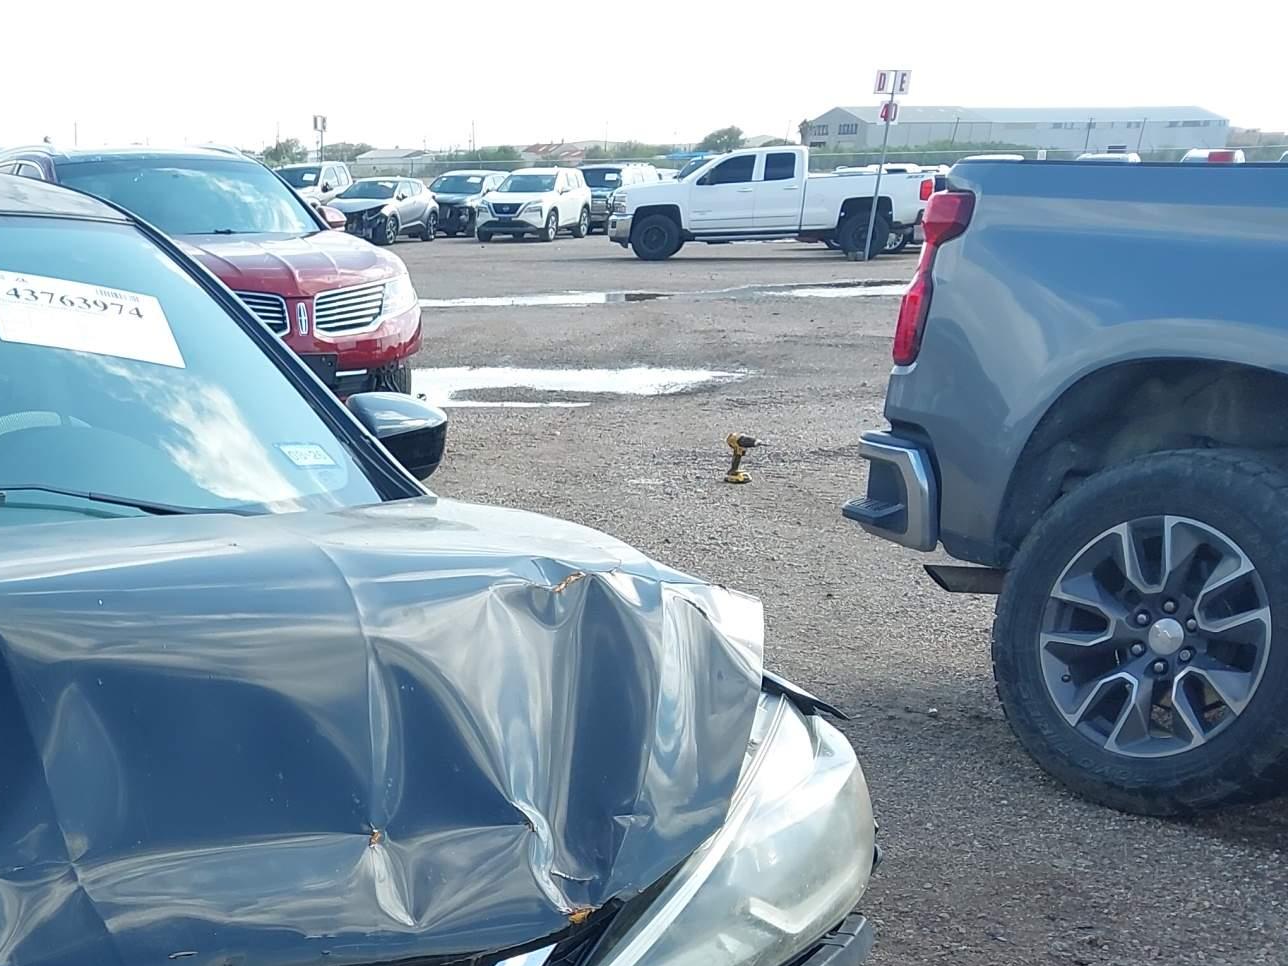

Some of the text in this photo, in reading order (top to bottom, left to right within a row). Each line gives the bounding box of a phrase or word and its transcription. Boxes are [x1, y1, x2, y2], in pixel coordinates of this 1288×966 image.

[877, 73, 907, 91] D E
[880, 103, 898, 121] 40
[5, 287, 144, 319] 43763974
